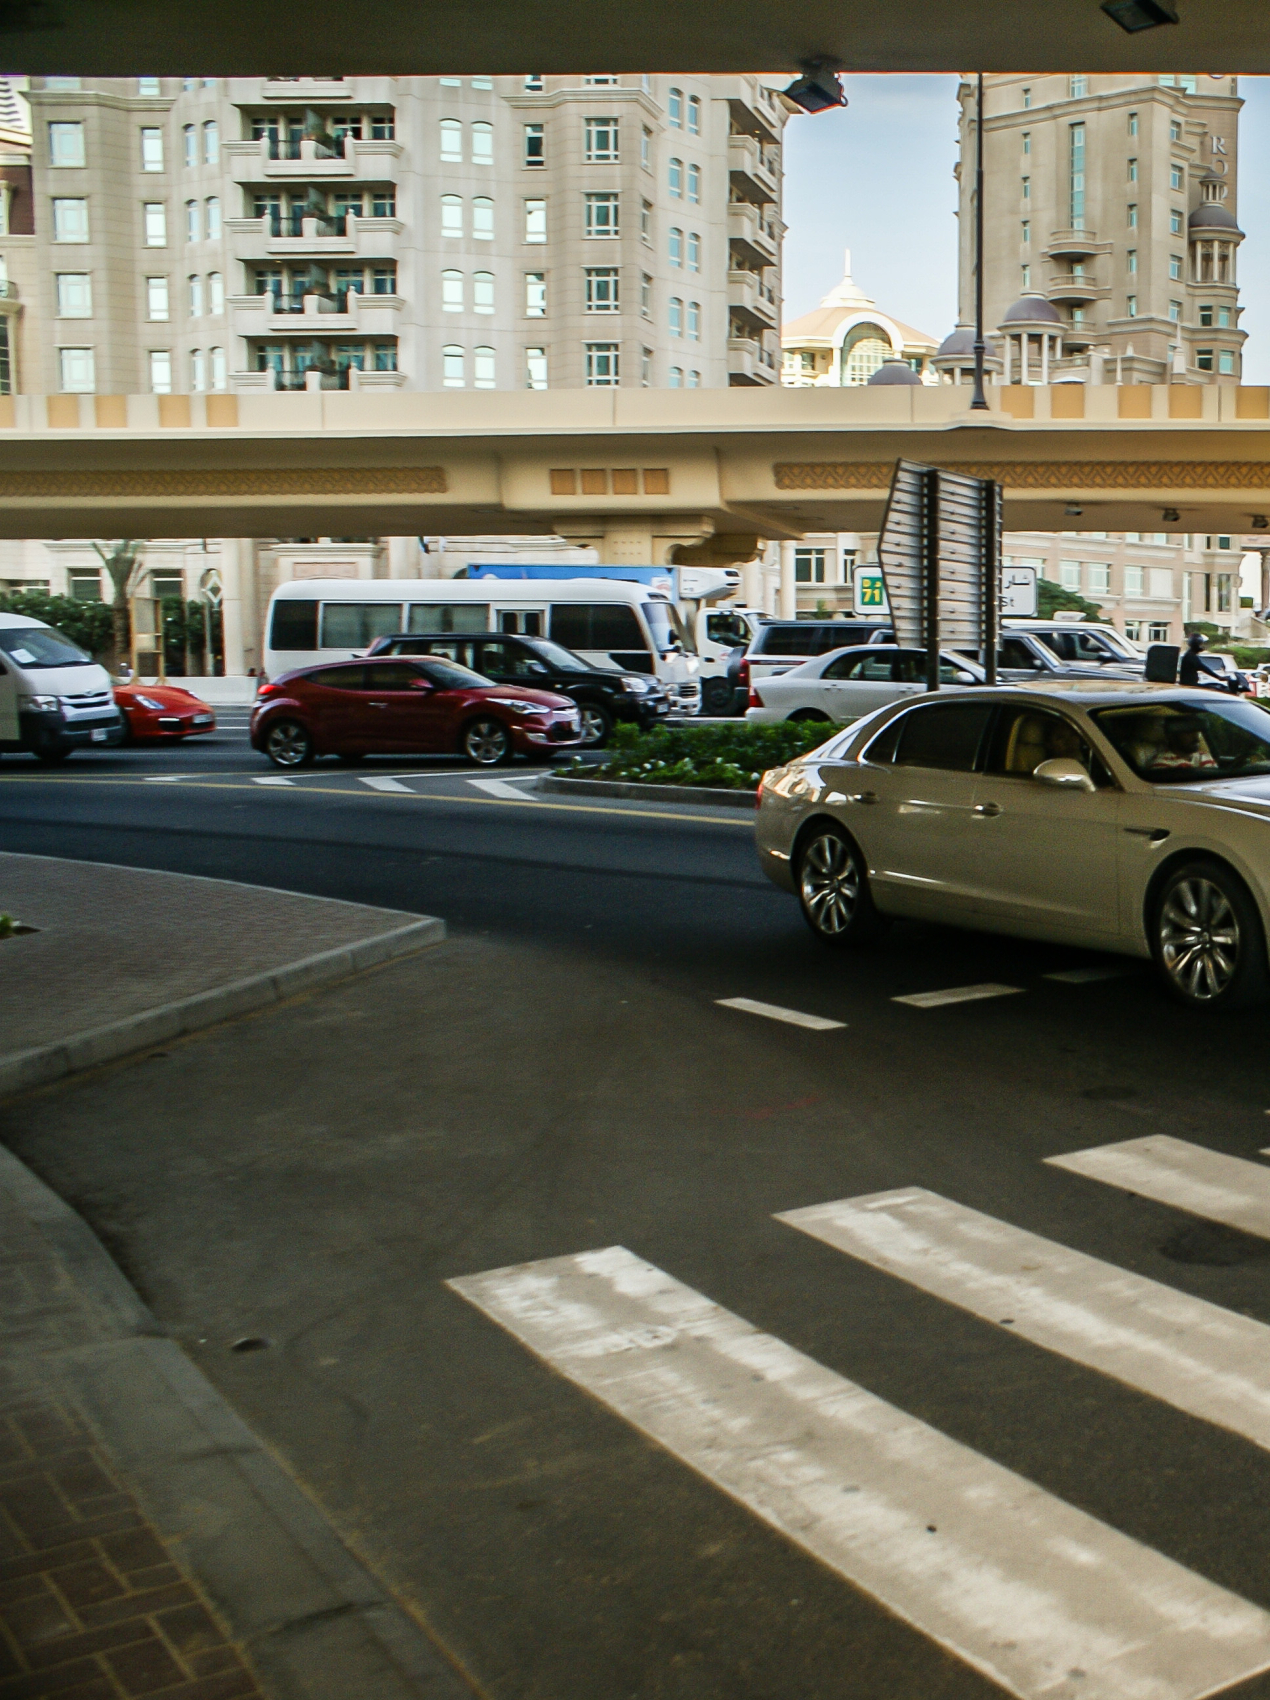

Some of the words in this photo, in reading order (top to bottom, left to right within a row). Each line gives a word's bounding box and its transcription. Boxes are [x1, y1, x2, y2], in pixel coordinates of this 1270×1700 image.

[862, 579, 871, 588] D
[1004, 574, 1031, 589] شار
[862, 588, 880, 603] 71
